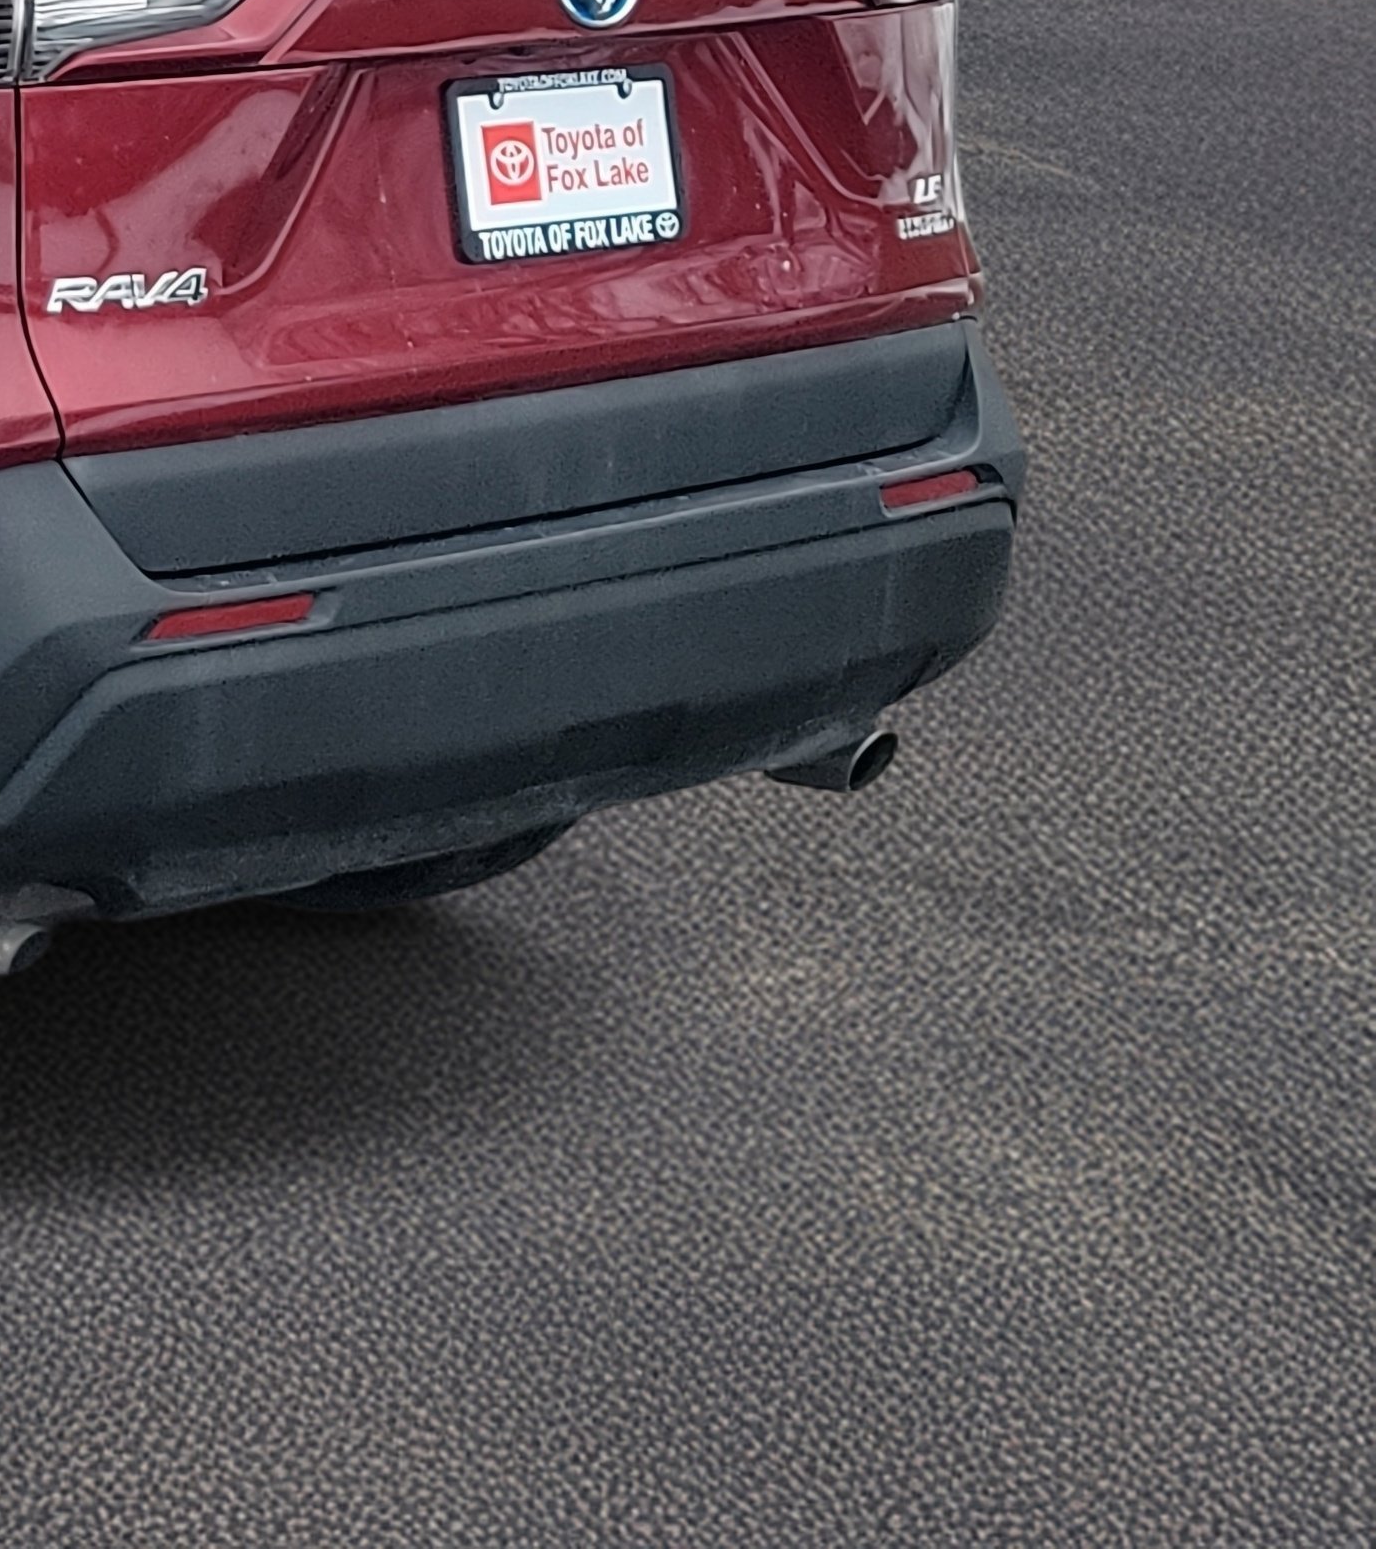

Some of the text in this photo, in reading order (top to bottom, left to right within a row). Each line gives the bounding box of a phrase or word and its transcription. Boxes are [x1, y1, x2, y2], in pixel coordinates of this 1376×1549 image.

[542, 118, 645, 160] Toyota of
[547, 157, 649, 193] Fox Lake
[478, 213, 655, 261] TOYOTA OF FOX LAKE
[46, 267, 209, 313] RAV4
